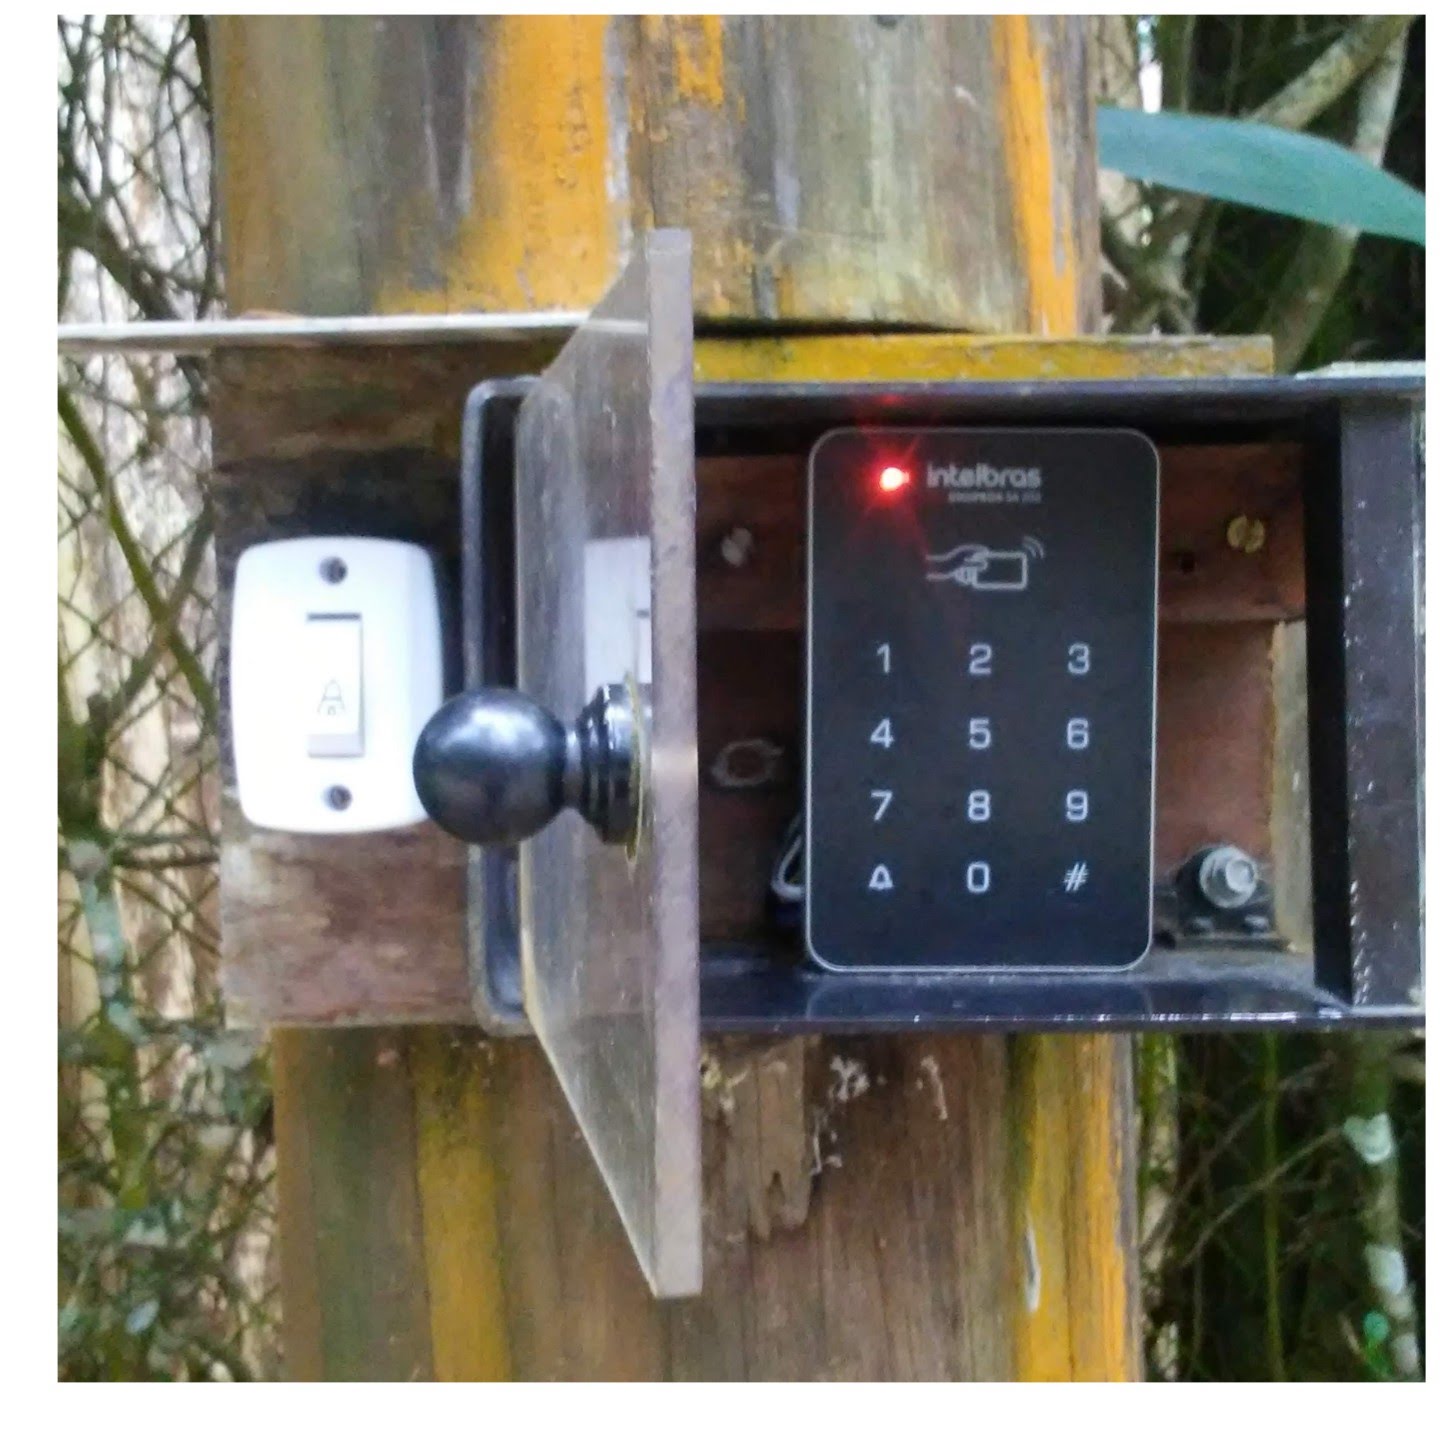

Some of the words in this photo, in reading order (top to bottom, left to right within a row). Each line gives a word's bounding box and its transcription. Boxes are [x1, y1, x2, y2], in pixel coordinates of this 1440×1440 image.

[926, 461, 1042, 489] intelbras
[875, 642, 892, 675] 1
[968, 642, 993, 676] 2
[1067, 642, 1091, 676] 3
[869, 717, 895, 749] 4
[968, 717, 992, 750] 5
[1066, 717, 1090, 750] 6
[870, 789, 894, 822] 7
[967, 789, 992, 822] 8
[1065, 789, 1090, 822] 9
[966, 861, 991, 894] 0
[1063, 860, 1090, 893] #
